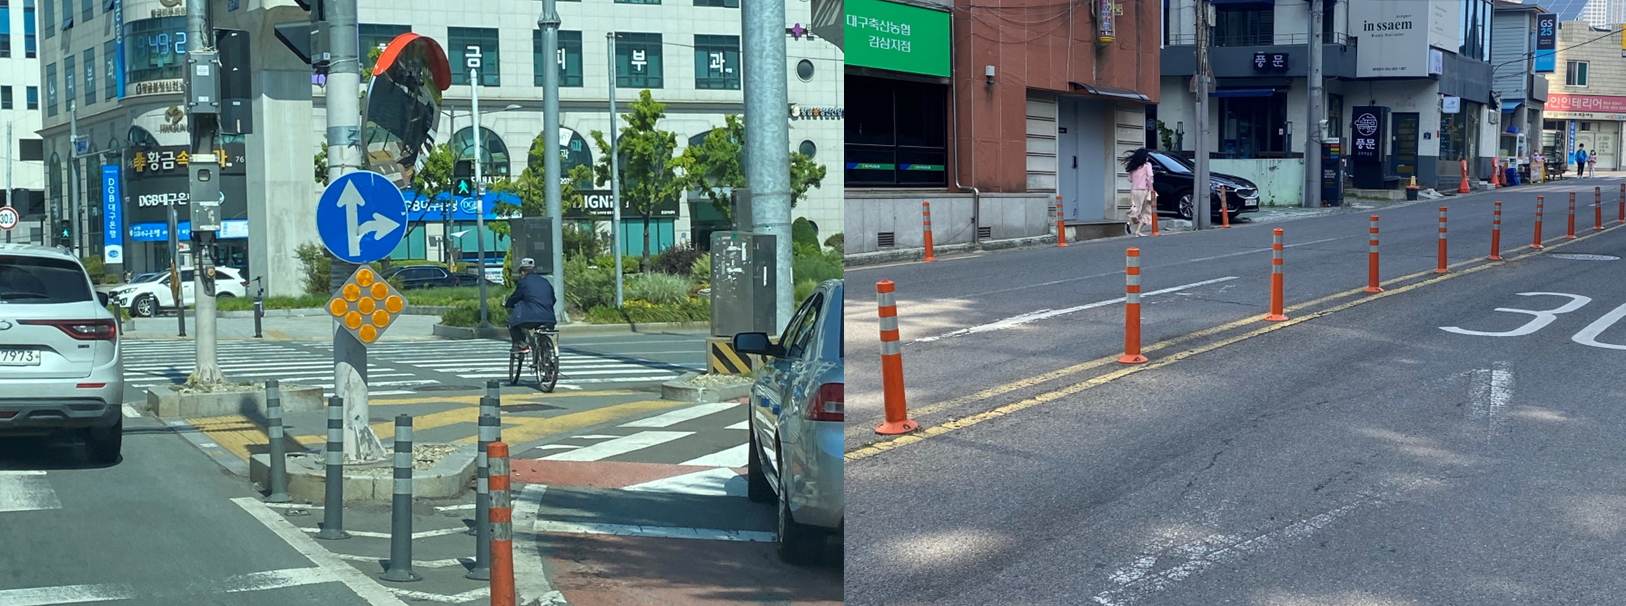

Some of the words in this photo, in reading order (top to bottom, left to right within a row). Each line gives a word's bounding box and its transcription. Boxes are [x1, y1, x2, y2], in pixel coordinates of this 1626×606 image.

[846, 14, 911, 36] 대구축산농협
[1363, 20, 1374, 31] in
[1376, 20, 1413, 31] ssaem
[1540, 20, 1553, 28] GS
[1540, 28, 1553, 36] 25
[868, 35, 911, 53] 감삼지점
[465, 45, 482, 67] 금
[631, 50, 647, 71] 부
[709, 52, 725, 73] 과
[107, 177, 117, 239] DGB대구은행
[0, 351, 34, 362] 7973
